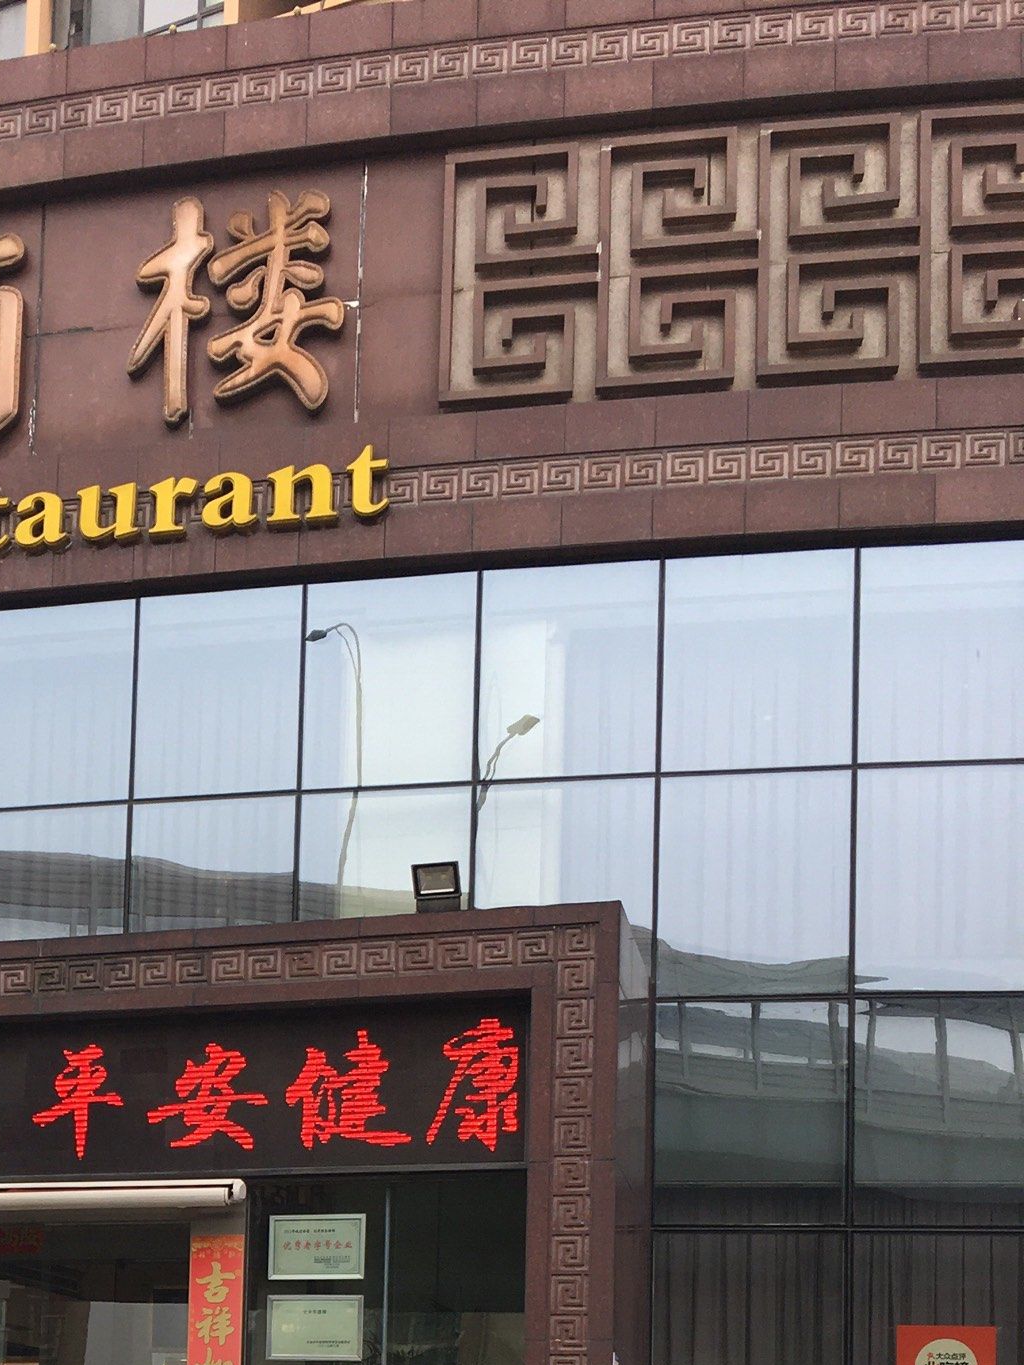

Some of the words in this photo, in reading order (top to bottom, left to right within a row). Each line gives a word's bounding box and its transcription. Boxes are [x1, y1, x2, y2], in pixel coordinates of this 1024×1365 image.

[32, 1018, 521, 1160] 平安健康
[935, 1352, 967, 1360] 大众点评
